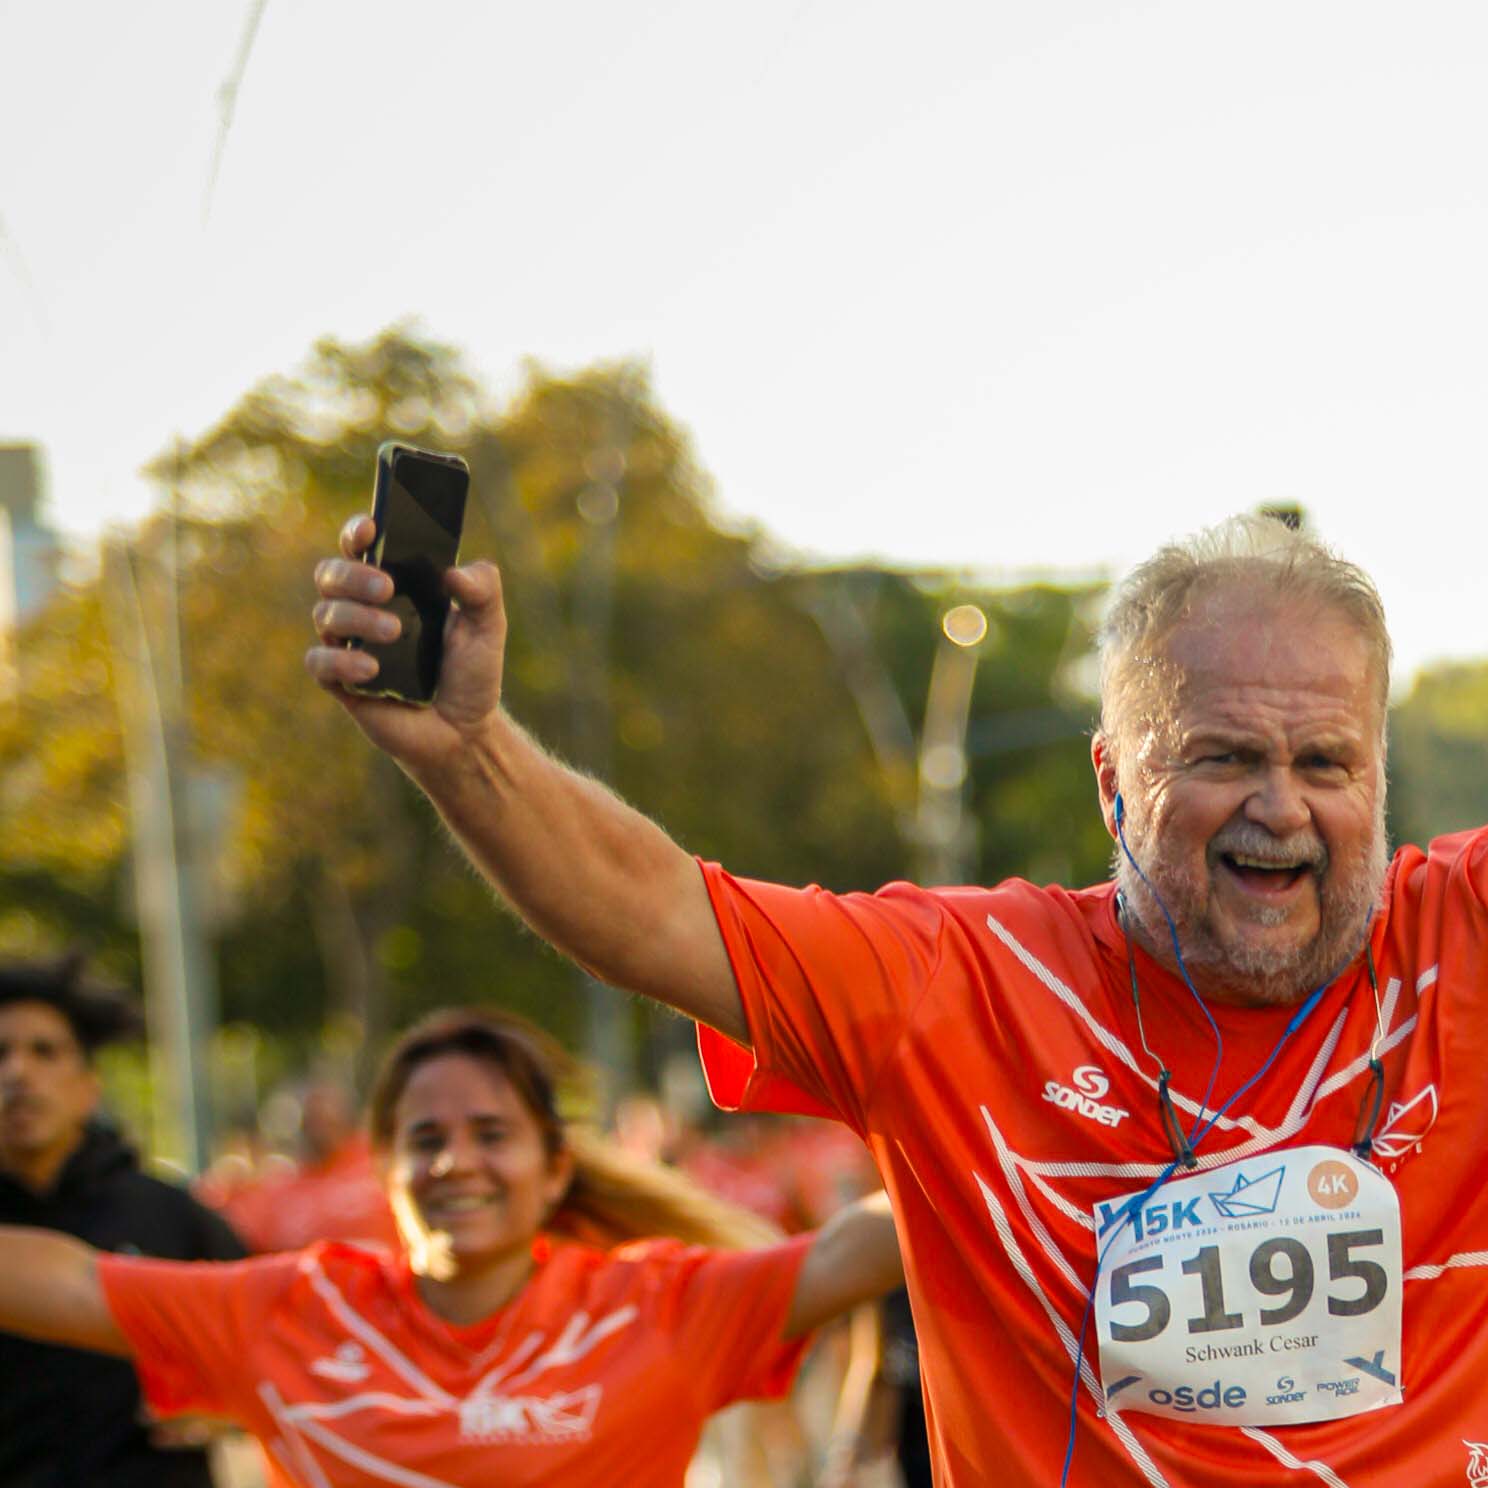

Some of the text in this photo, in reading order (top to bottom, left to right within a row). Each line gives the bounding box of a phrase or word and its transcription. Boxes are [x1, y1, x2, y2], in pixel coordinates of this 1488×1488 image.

[1317, 1174, 1349, 1194] 4K
[1227, 1221, 1268, 1231] ROSARIO
[1109, 1228, 1388, 1343] 5195
[1185, 1334, 1319, 1363] Schwank Cesar
[1148, 1380, 1247, 1412] osde
